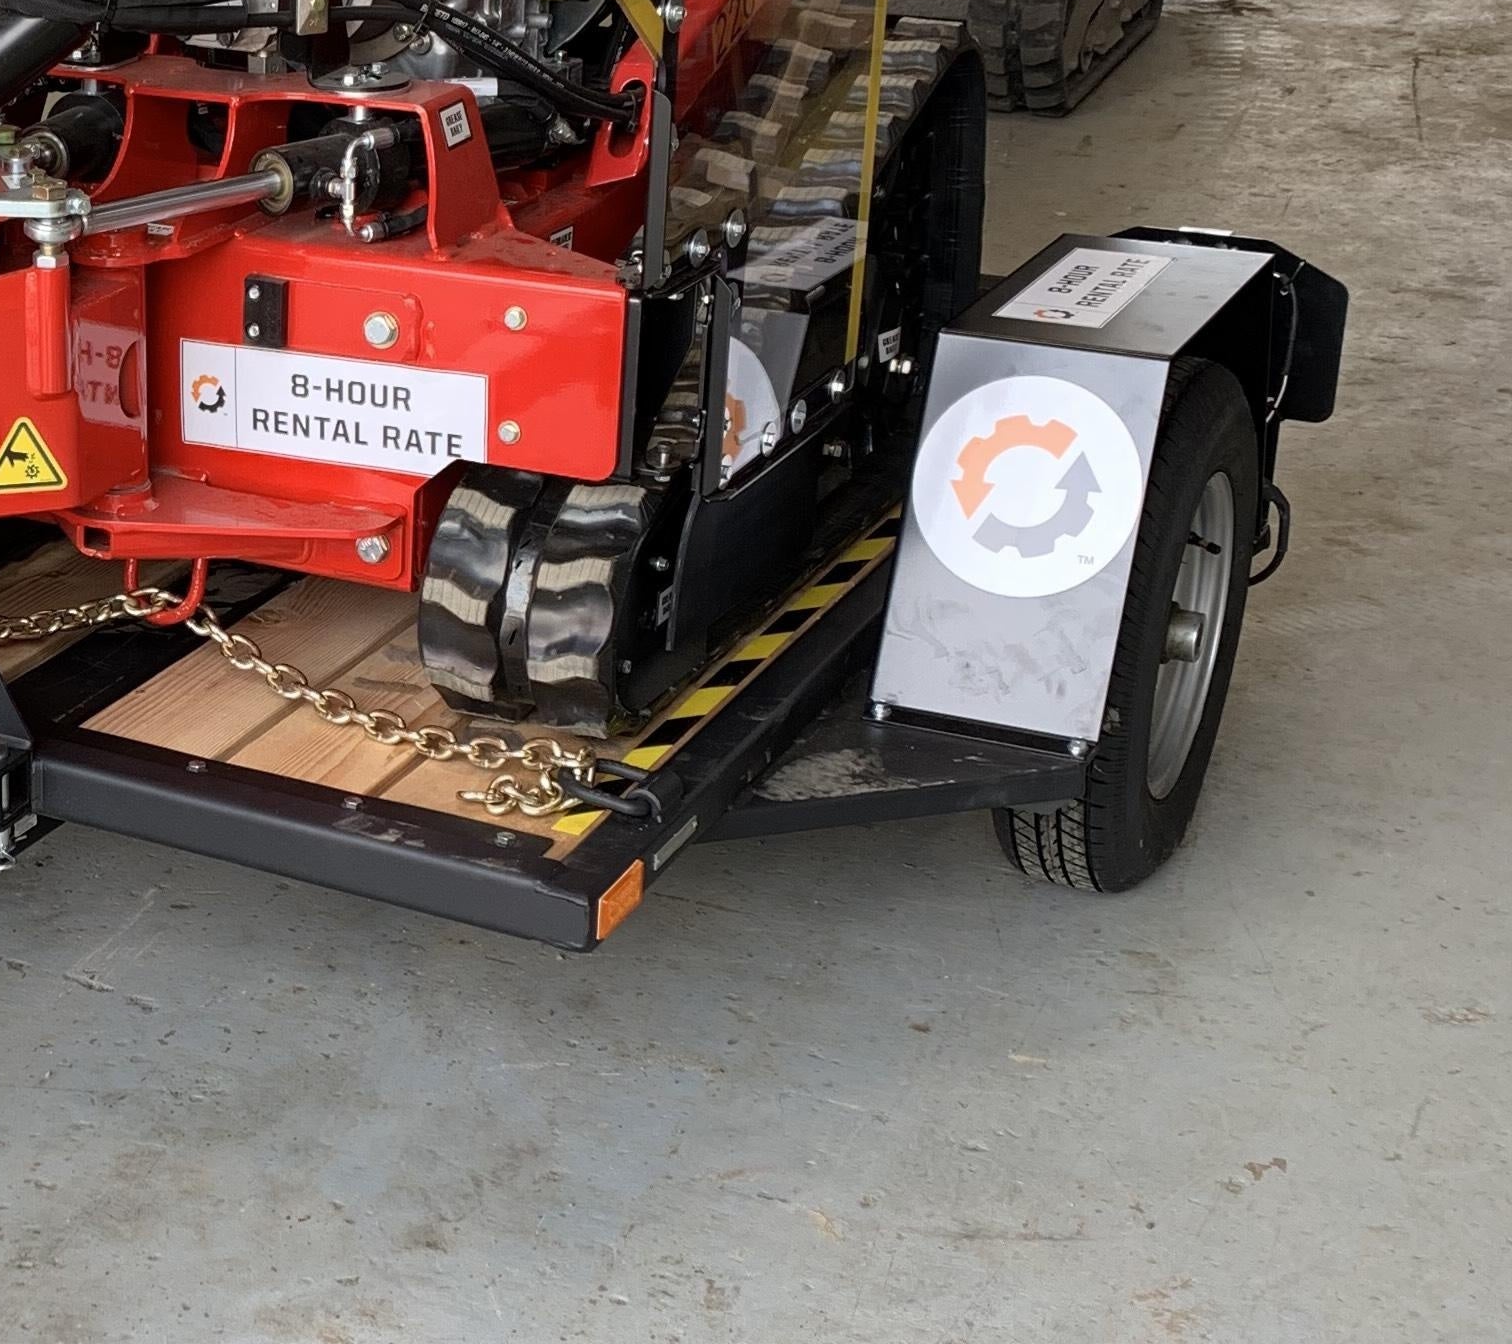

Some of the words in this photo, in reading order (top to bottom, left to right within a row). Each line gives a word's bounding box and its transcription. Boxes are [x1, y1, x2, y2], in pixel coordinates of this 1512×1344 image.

[1047, 264, 1100, 294] 8-HOUR
[1075, 279, 1127, 308] RENTAL
[1110, 257, 1152, 278] RATE
[291, 373, 412, 412] 8-HOUR
[252, 408, 369, 446] RENTAL
[382, 424, 463, 458] RATE
